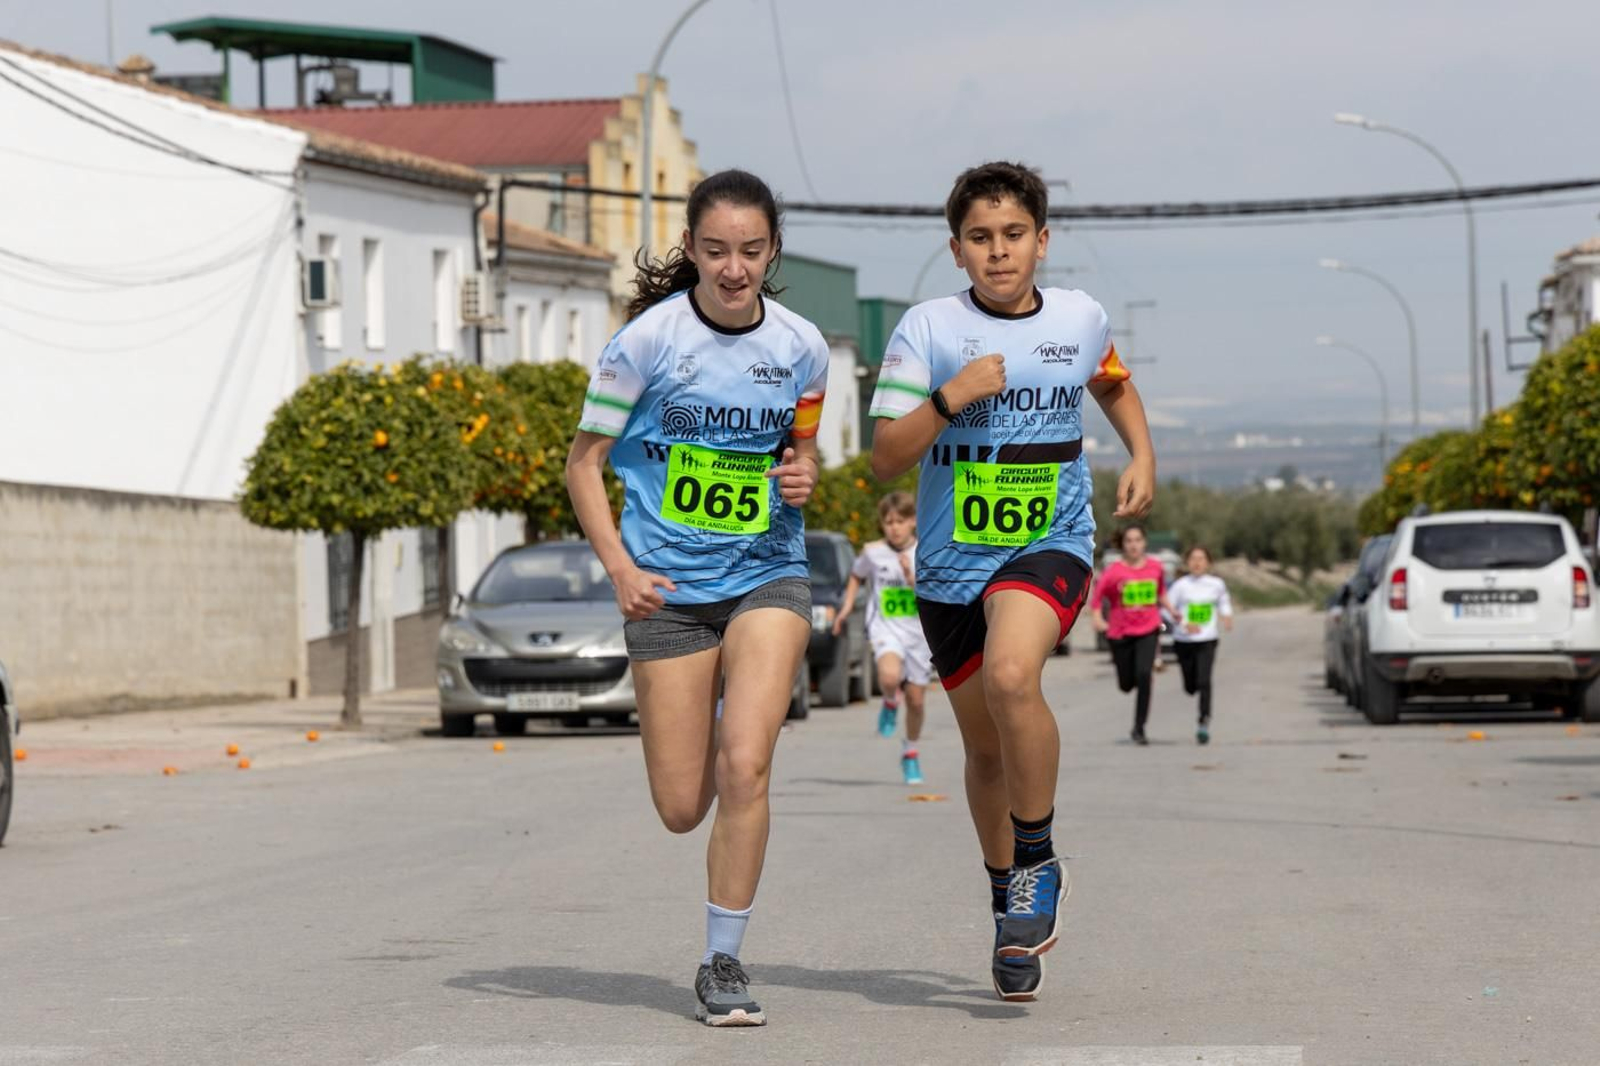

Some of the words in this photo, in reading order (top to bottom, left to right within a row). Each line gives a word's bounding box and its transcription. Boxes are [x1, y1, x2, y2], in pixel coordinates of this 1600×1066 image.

[993, 385, 1083, 411] MOLINO
[704, 406, 796, 432] MOLINO
[992, 414, 1012, 427] DE
[1013, 413, 1036, 427] LAS
[1040, 410, 1078, 425] TORRES
[702, 428, 719, 441] DE
[719, 454, 764, 464] CIRCUITO
[711, 460, 767, 473] RUNNING
[1001, 467, 1050, 475] CIRCUITO
[995, 475, 1054, 484] RUNNING
[673, 476, 760, 522] 065
[963, 495, 1049, 533] 068
[885, 599, 916, 613] 01
